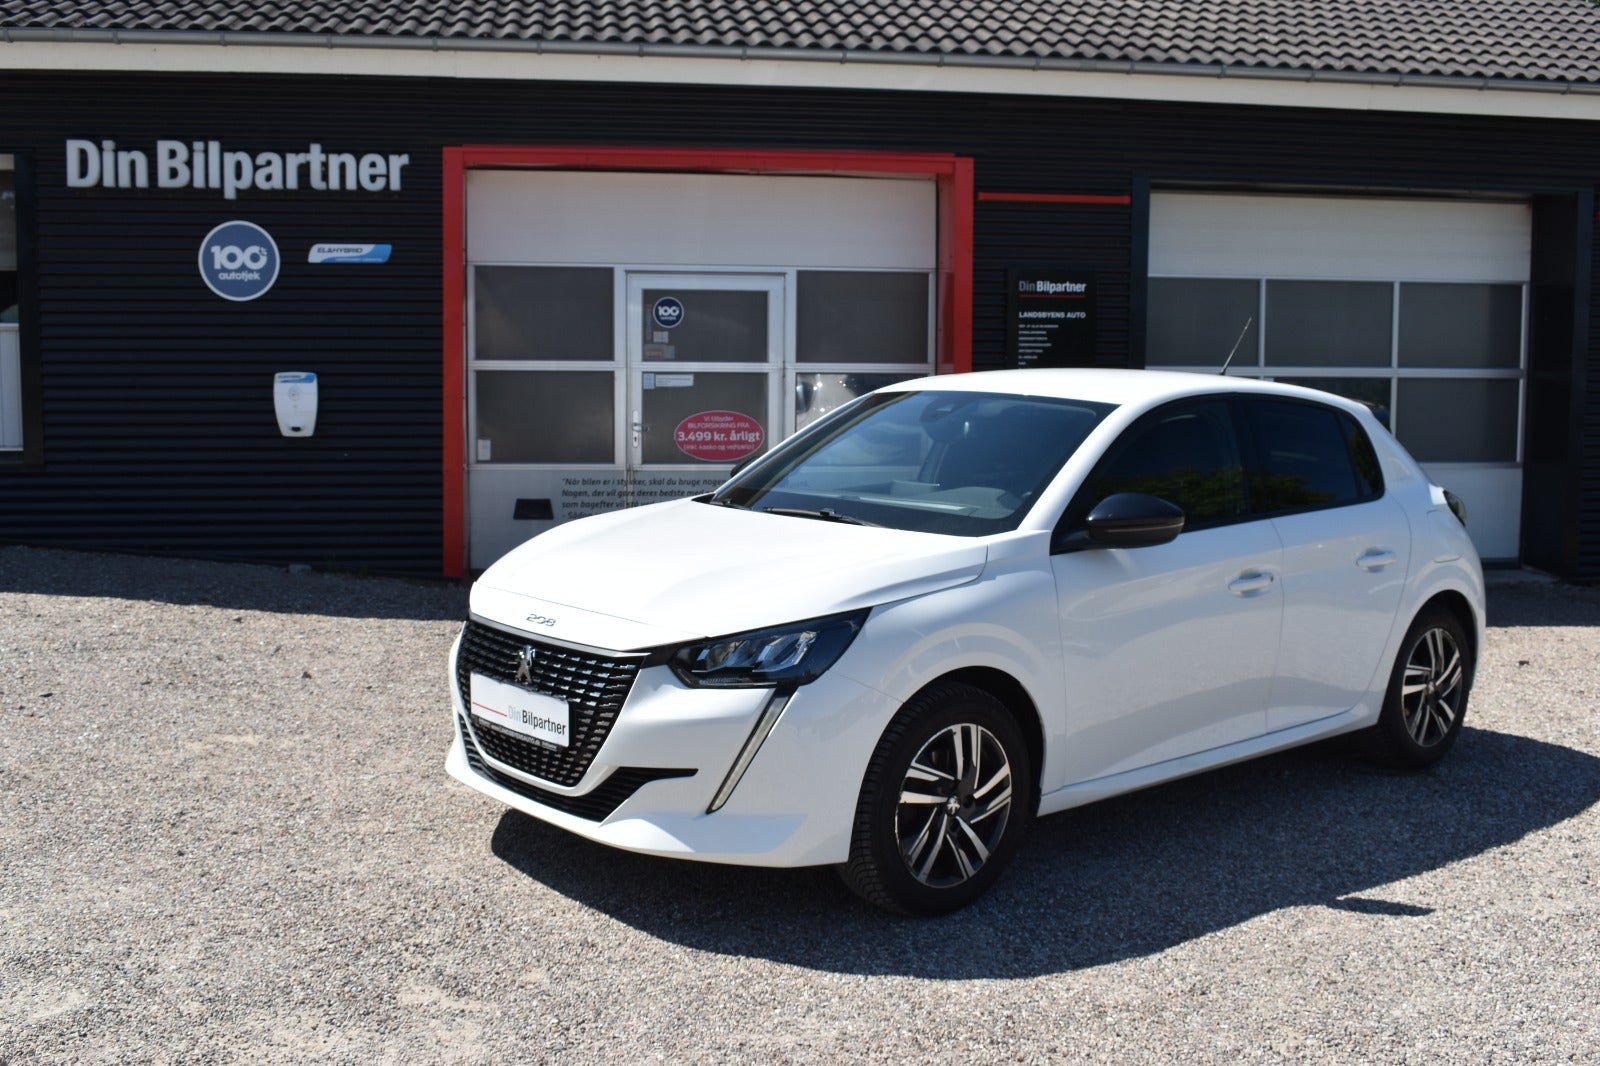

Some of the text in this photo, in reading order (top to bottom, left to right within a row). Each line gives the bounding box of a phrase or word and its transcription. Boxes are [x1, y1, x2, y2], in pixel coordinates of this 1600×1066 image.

[66, 139, 410, 200] Din Bilpartner
[218, 271, 261, 281] autotjek
[1019, 281, 1086, 293] Din Bilpartner
[678, 430, 760, 442] 3.499 kr. årligt
[649, 478, 665, 486] skal
[667, 478, 676, 486] du
[679, 478, 701, 487] bruge
[592, 489, 605, 497] der
[607, 489, 617, 497] vil
[659, 489, 685, 497] bedste
[581, 500, 614, 510] bagefter
[526, 613, 555, 626] 208
[508, 705, 522, 722] Din
[522, 710, 567, 735] Bilpartner
